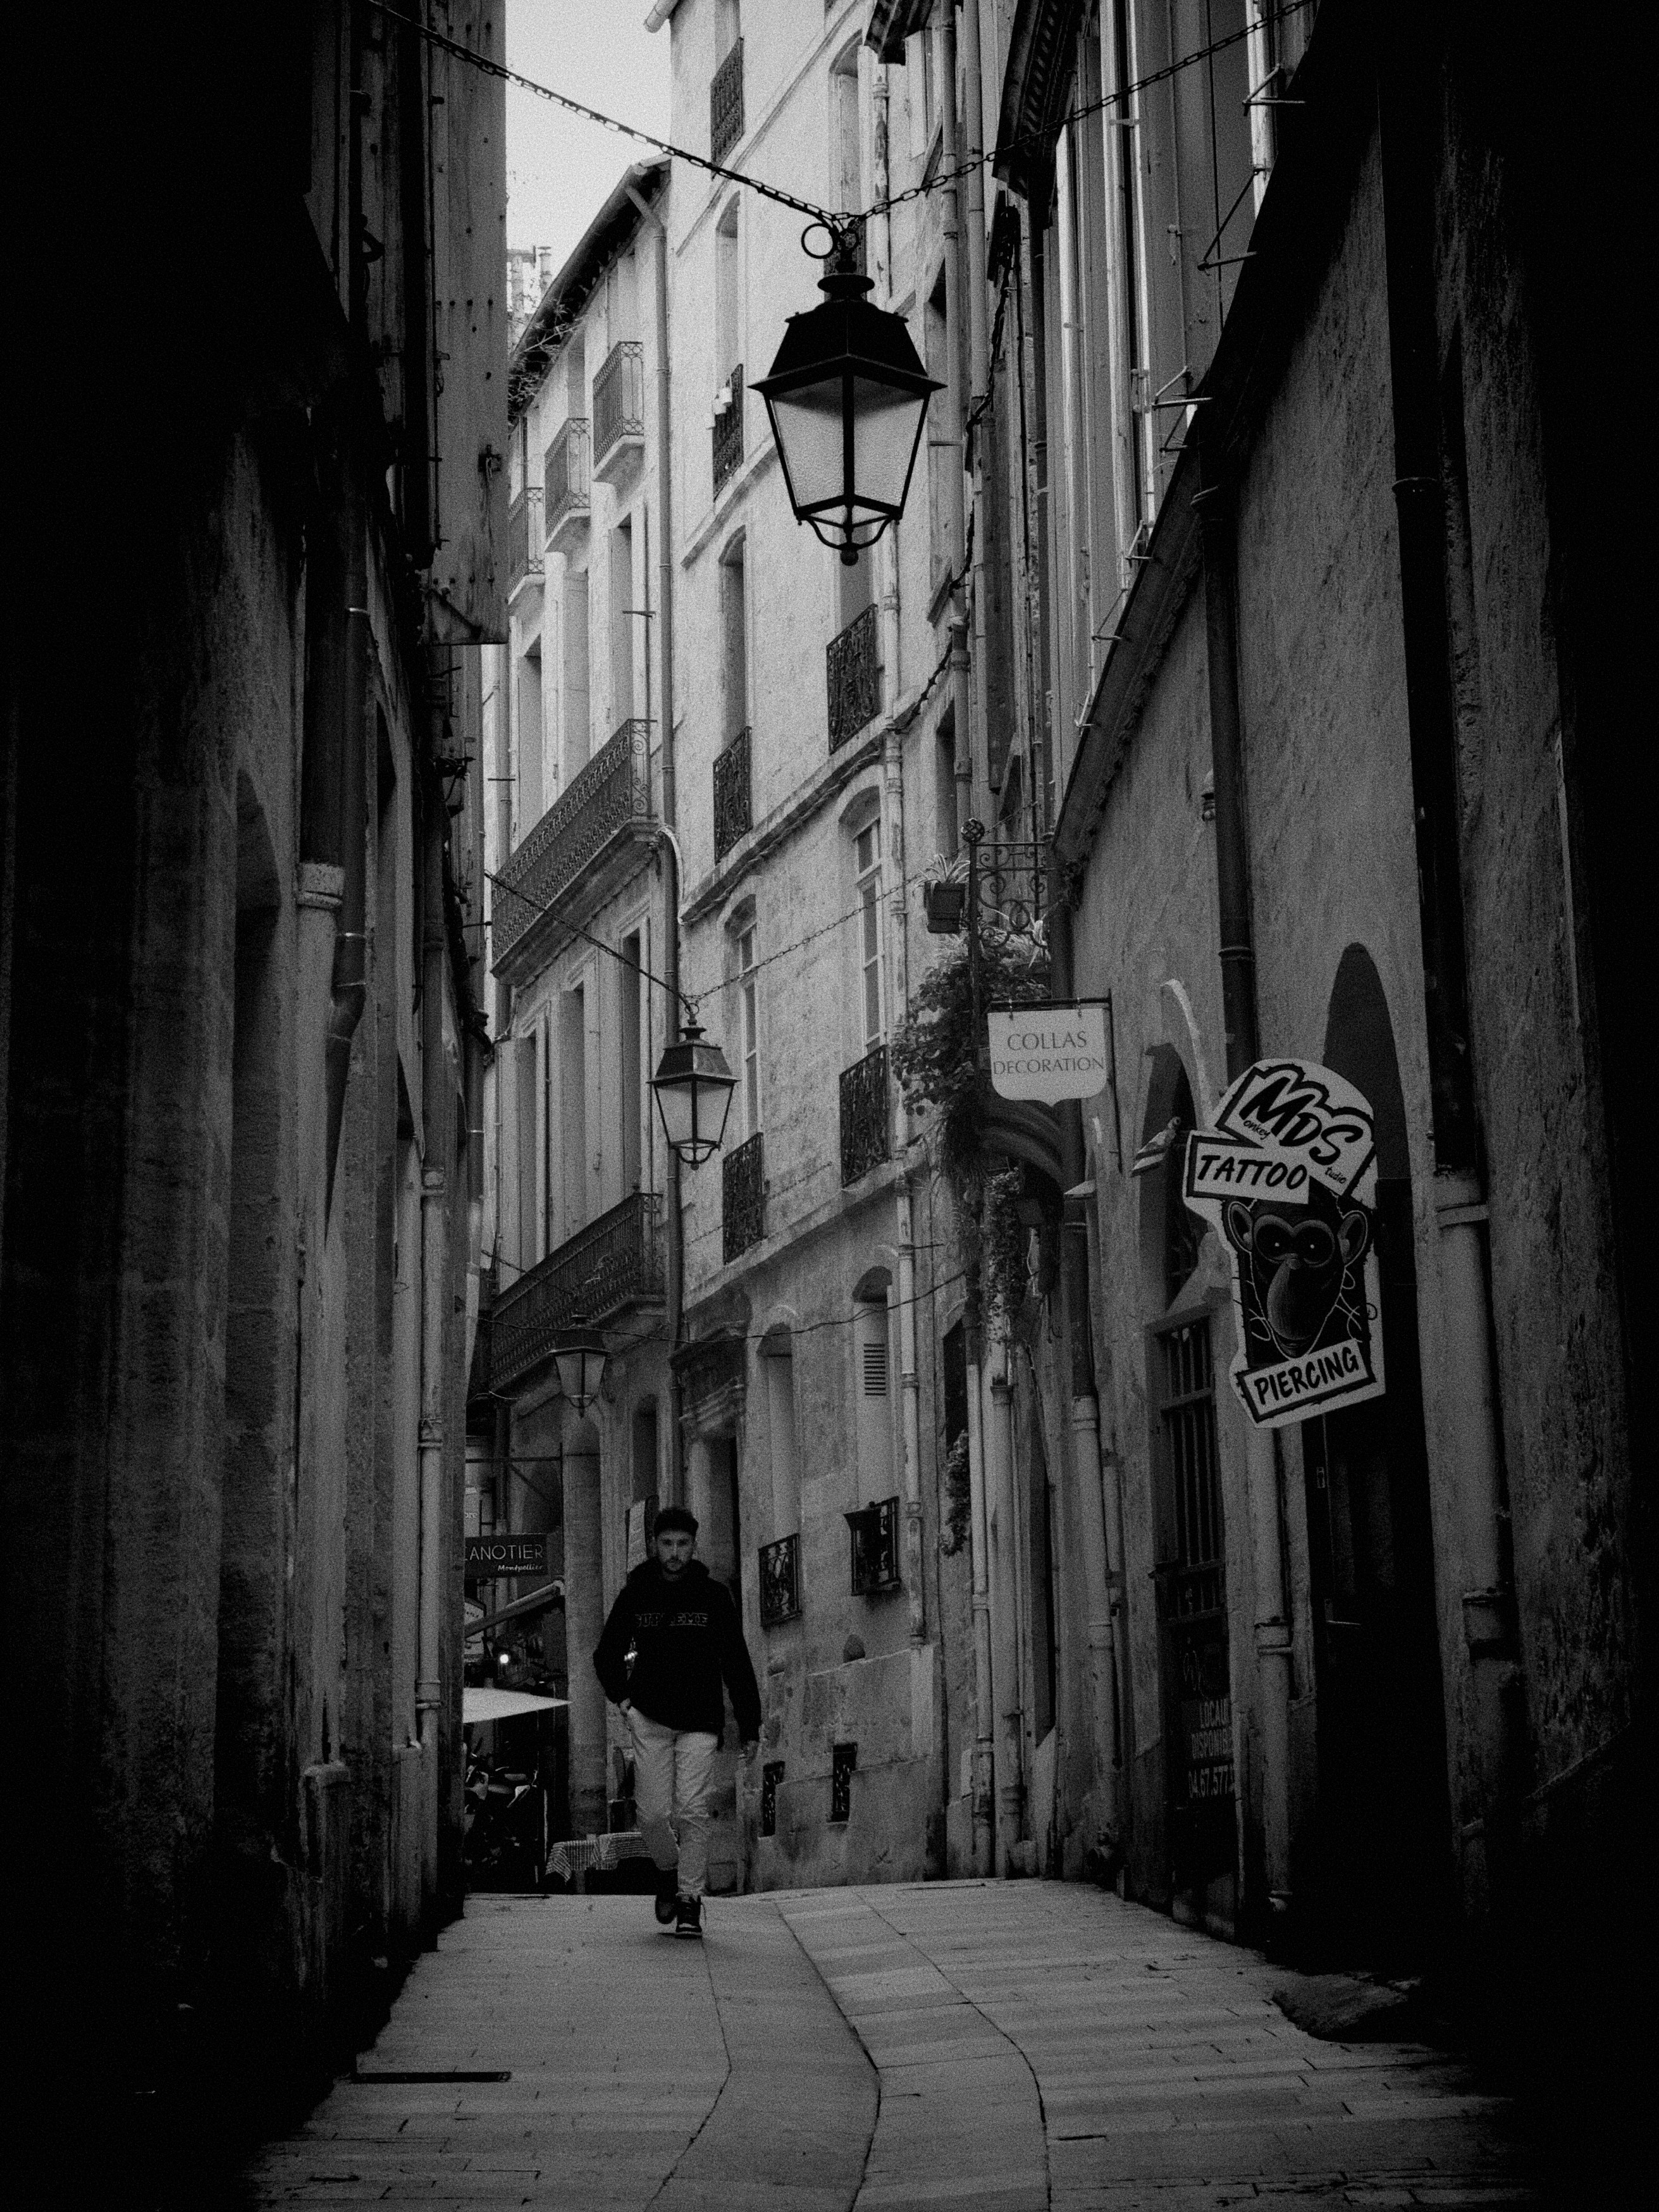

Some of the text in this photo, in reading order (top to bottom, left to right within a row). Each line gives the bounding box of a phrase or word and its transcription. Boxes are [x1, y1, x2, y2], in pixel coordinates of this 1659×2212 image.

[1007, 1030, 1087, 1051] COLLAS
[993, 1057, 1104, 1075] DECORATION
[1238, 1077, 1364, 1165] MDS
[1243, 1119, 1271, 1140] onkey
[1197, 1154, 1307, 1190] TATTOO
[1324, 1166, 1347, 1184] tudio
[1254, 1345, 1360, 1406] PIERCING
[464, 1543, 544, 1561] ANOTIER
